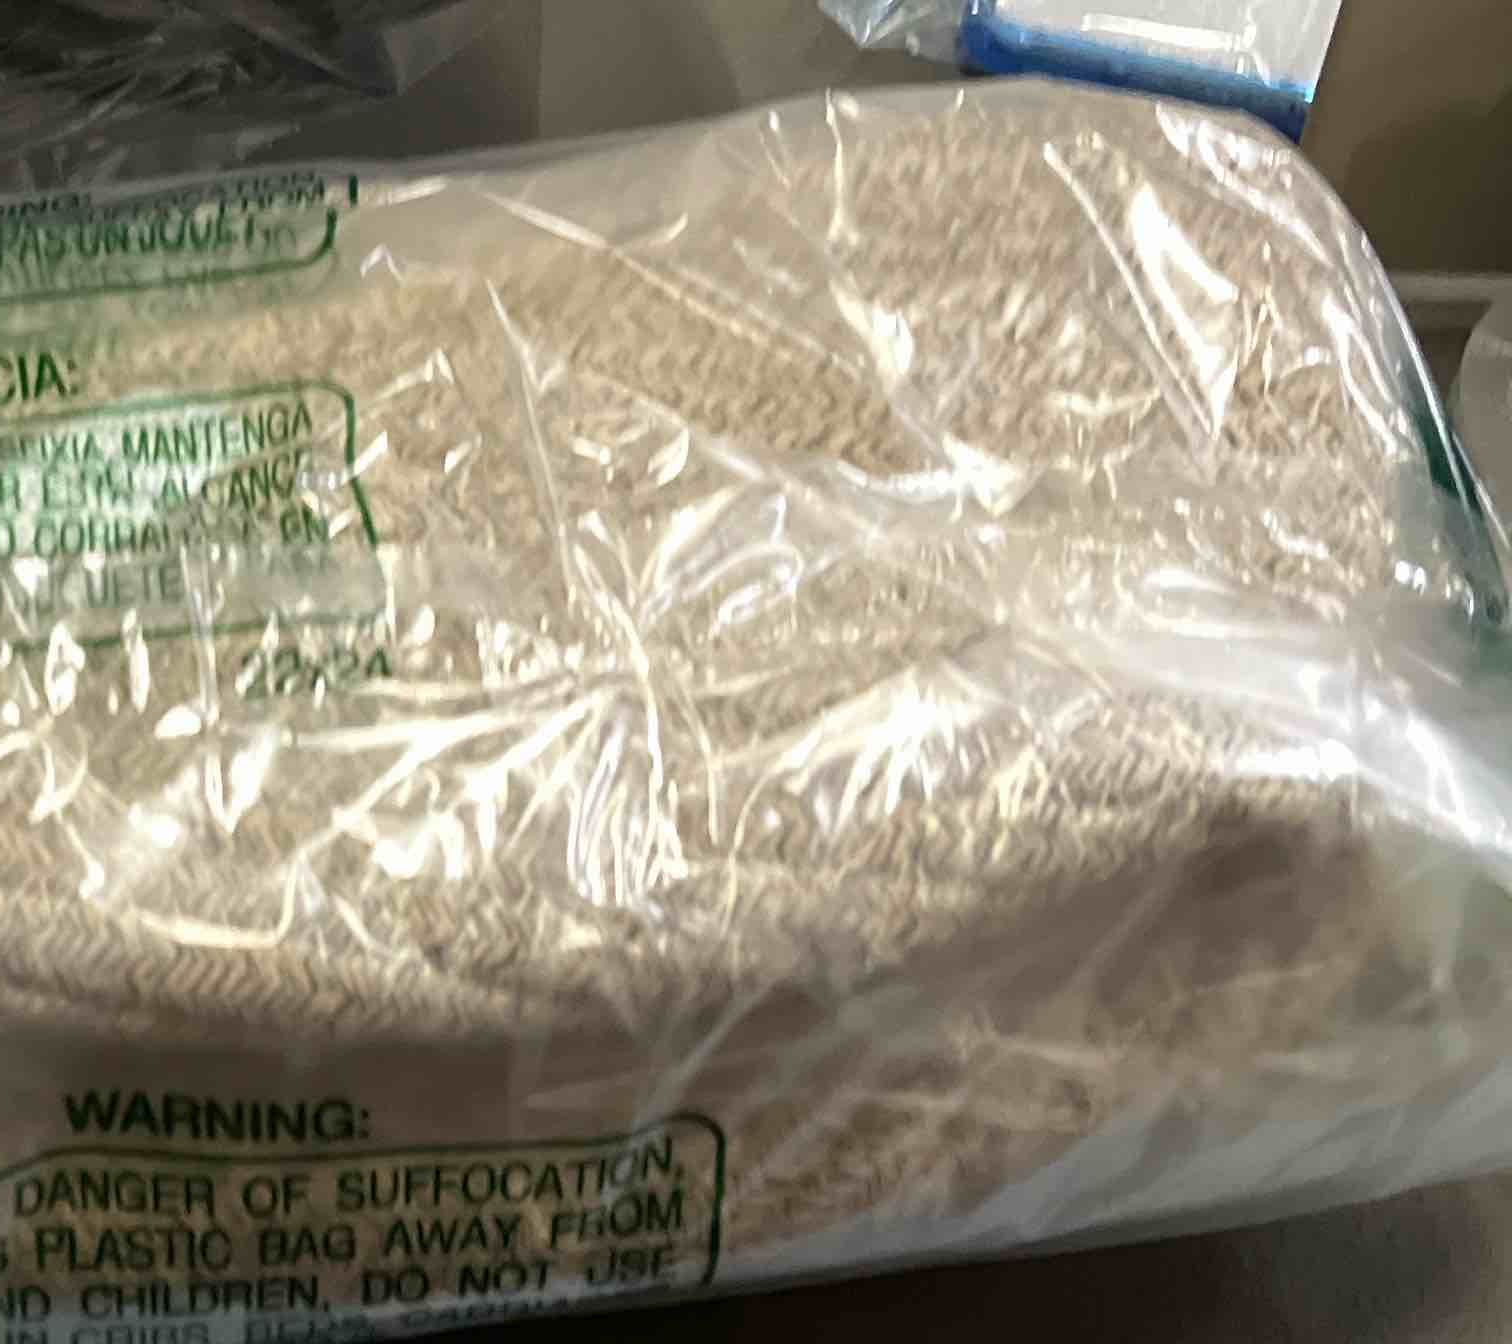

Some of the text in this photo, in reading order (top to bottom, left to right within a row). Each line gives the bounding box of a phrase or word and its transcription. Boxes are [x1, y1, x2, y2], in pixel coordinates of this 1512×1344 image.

[64, 1089, 370, 1143] WARNING:
[13, 1167, 216, 1220] DANGER
[241, 1171, 312, 1221] OF
[33, 1224, 233, 1273] PLASTIC
[257, 1223, 358, 1270] BAG
[384, 1212, 522, 1257] AWAY
[548, 1185, 685, 1251] FROM
[360, 1262, 431, 1306] DO
[458, 1258, 555, 1297] NOT
